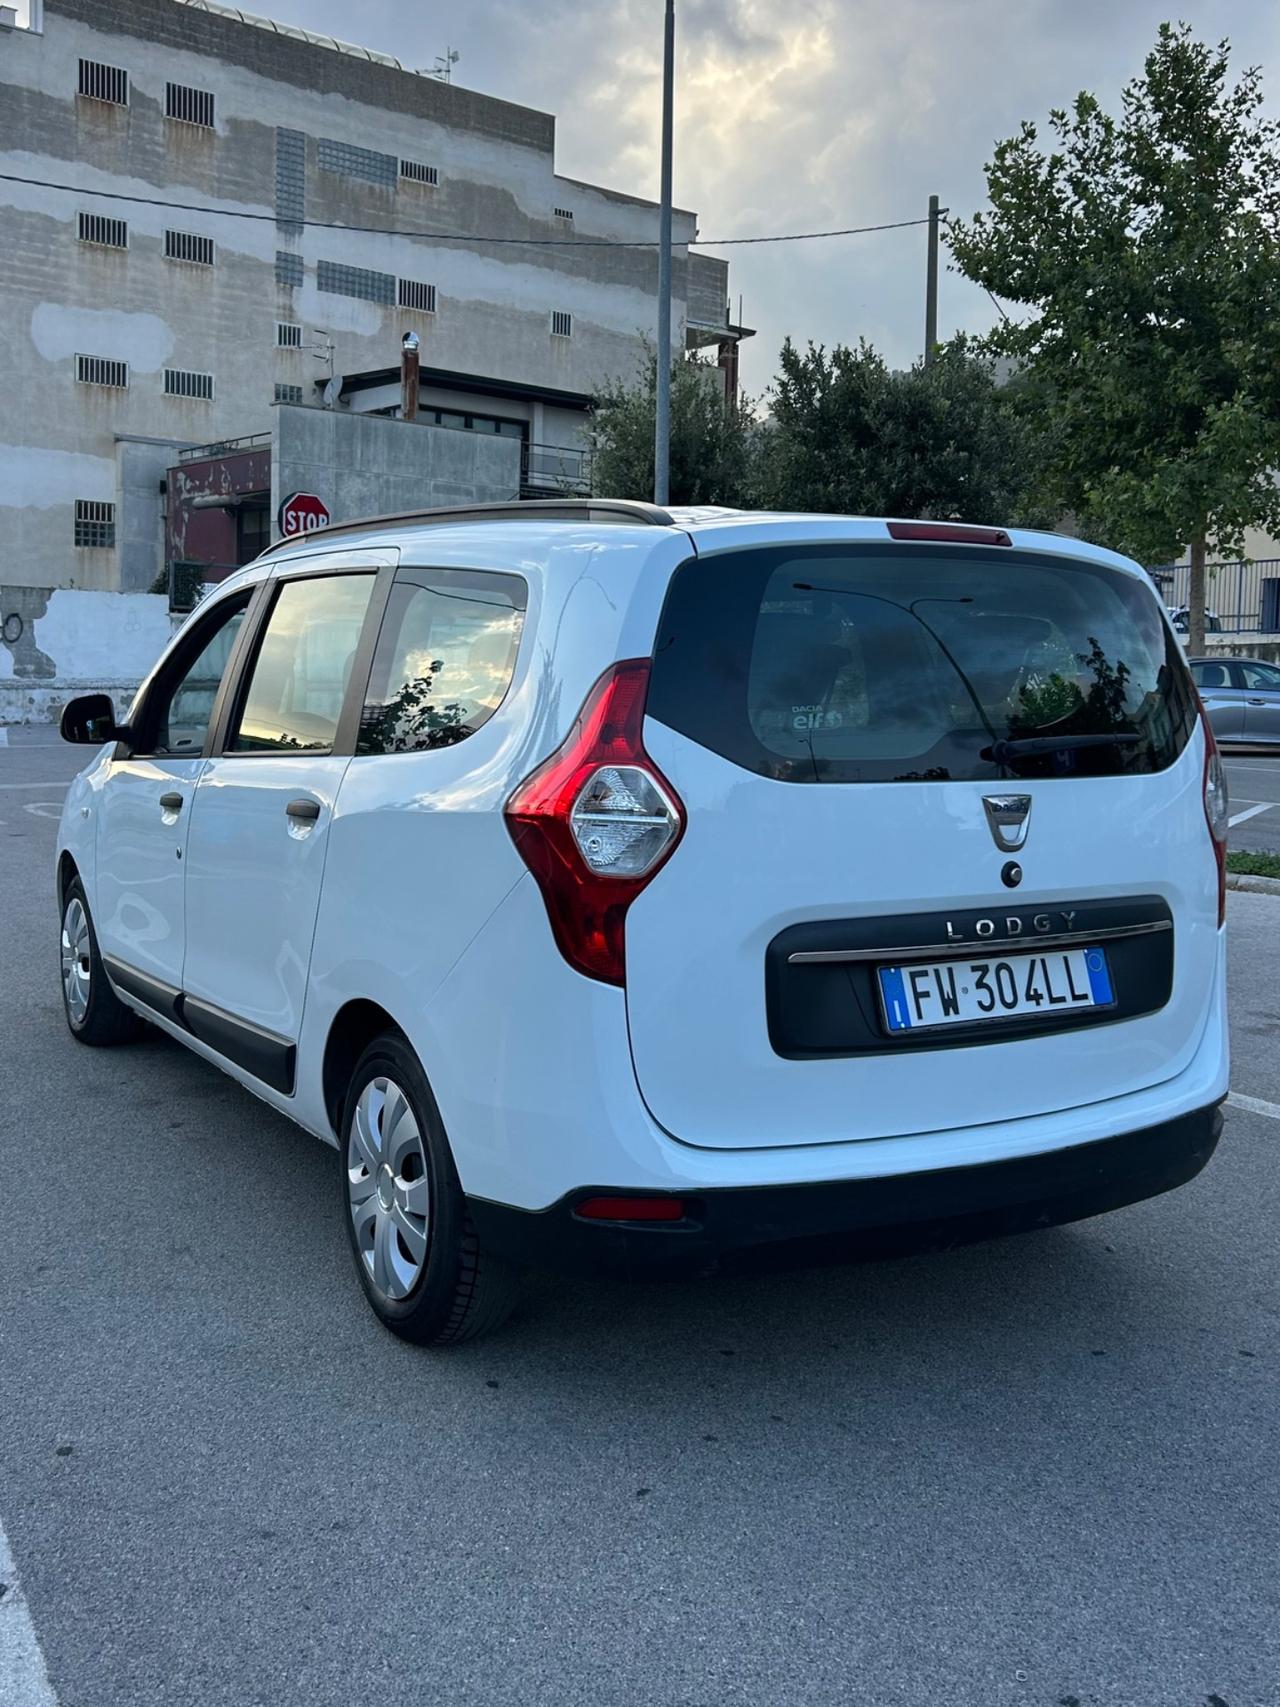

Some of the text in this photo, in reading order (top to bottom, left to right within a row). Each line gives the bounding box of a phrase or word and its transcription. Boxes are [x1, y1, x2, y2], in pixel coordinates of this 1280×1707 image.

[287, 510, 328, 531] STOP
[792, 704, 823, 713] DACIA
[793, 712, 824, 729] elf
[946, 911, 1075, 938] LODGY
